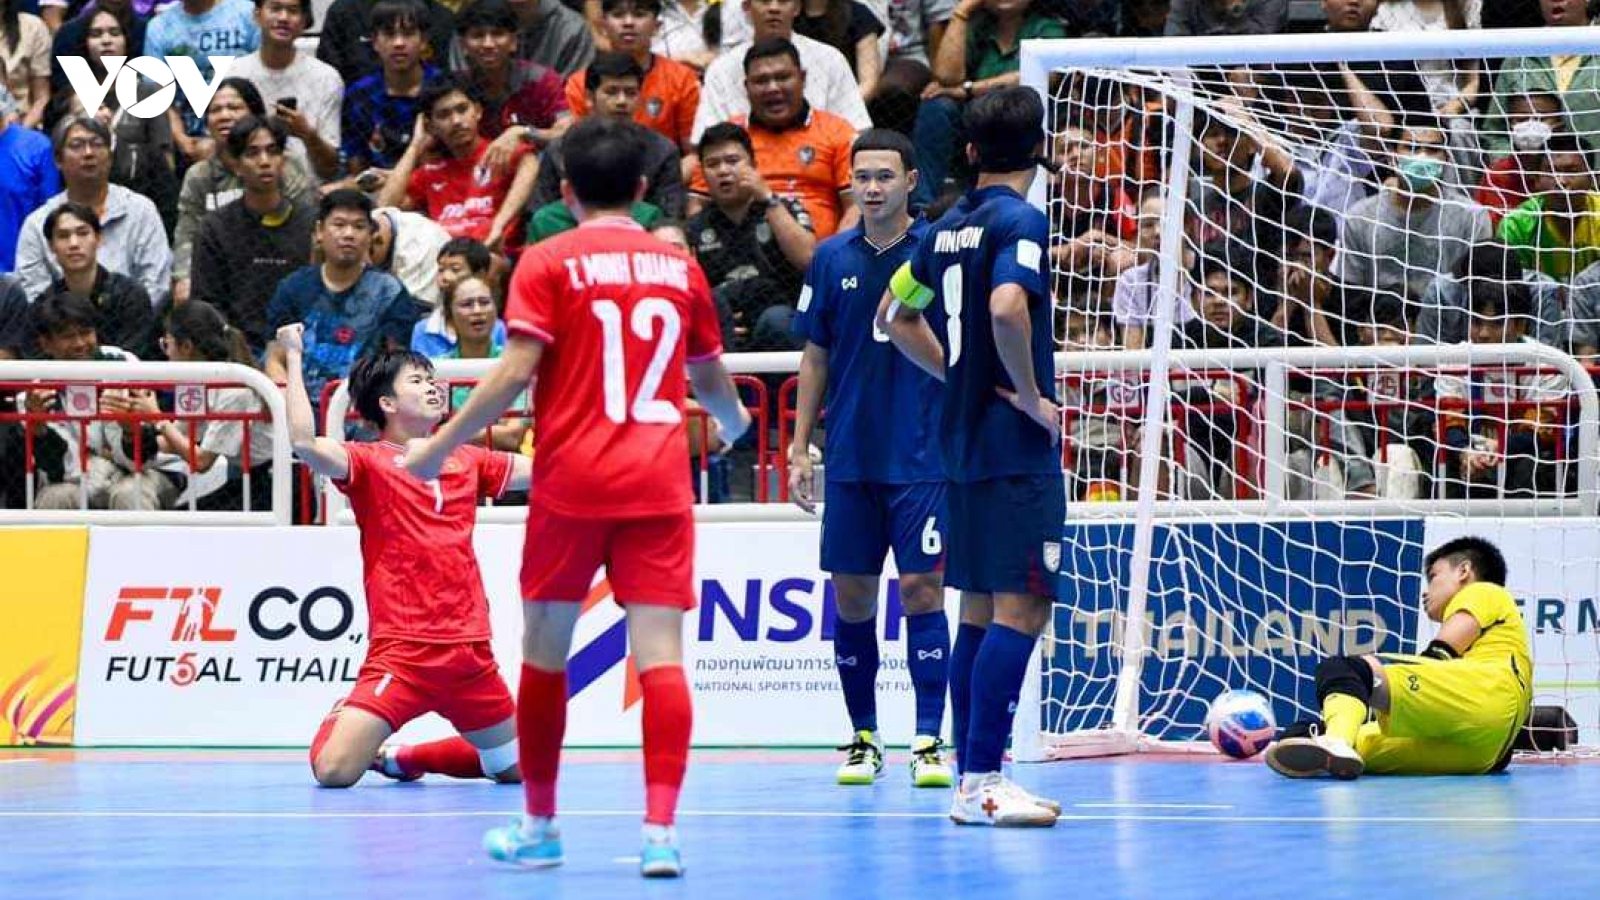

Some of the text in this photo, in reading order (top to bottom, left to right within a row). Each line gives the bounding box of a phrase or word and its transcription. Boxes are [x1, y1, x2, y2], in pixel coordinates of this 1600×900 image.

[592, 297, 682, 423] 12
[922, 516, 942, 555] 6
[256, 657, 358, 682] THAIL
[694, 680, 752, 691] NATIONAL
[758, 680, 801, 691] SPORTS
